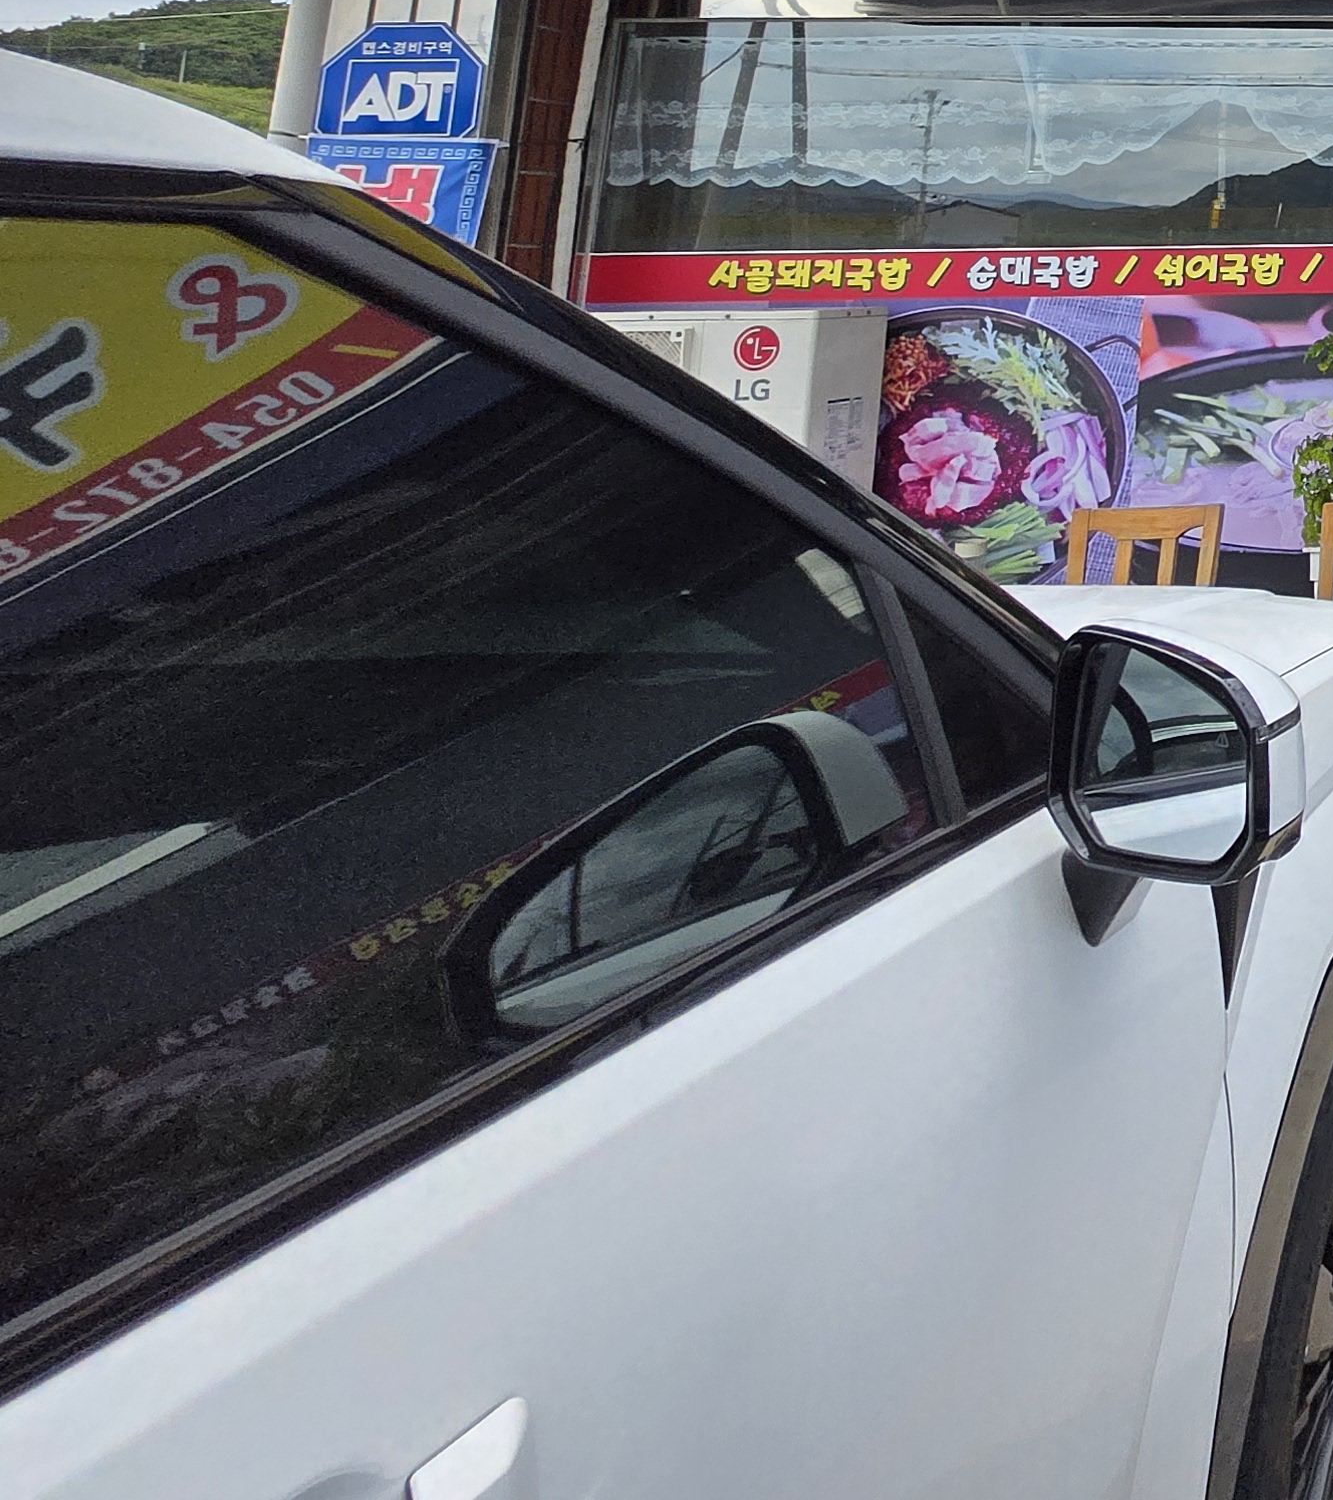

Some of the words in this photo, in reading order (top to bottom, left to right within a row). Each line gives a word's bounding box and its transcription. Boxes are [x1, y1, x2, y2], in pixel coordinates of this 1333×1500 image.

[343, 72, 456, 121] ADT
[709, 258, 910, 292] 사골돼지국밥
[967, 255, 1098, 289] 순대국밥
[1154, 252, 1284, 288] 섞어국밥
[735, 379, 770, 401] LG
